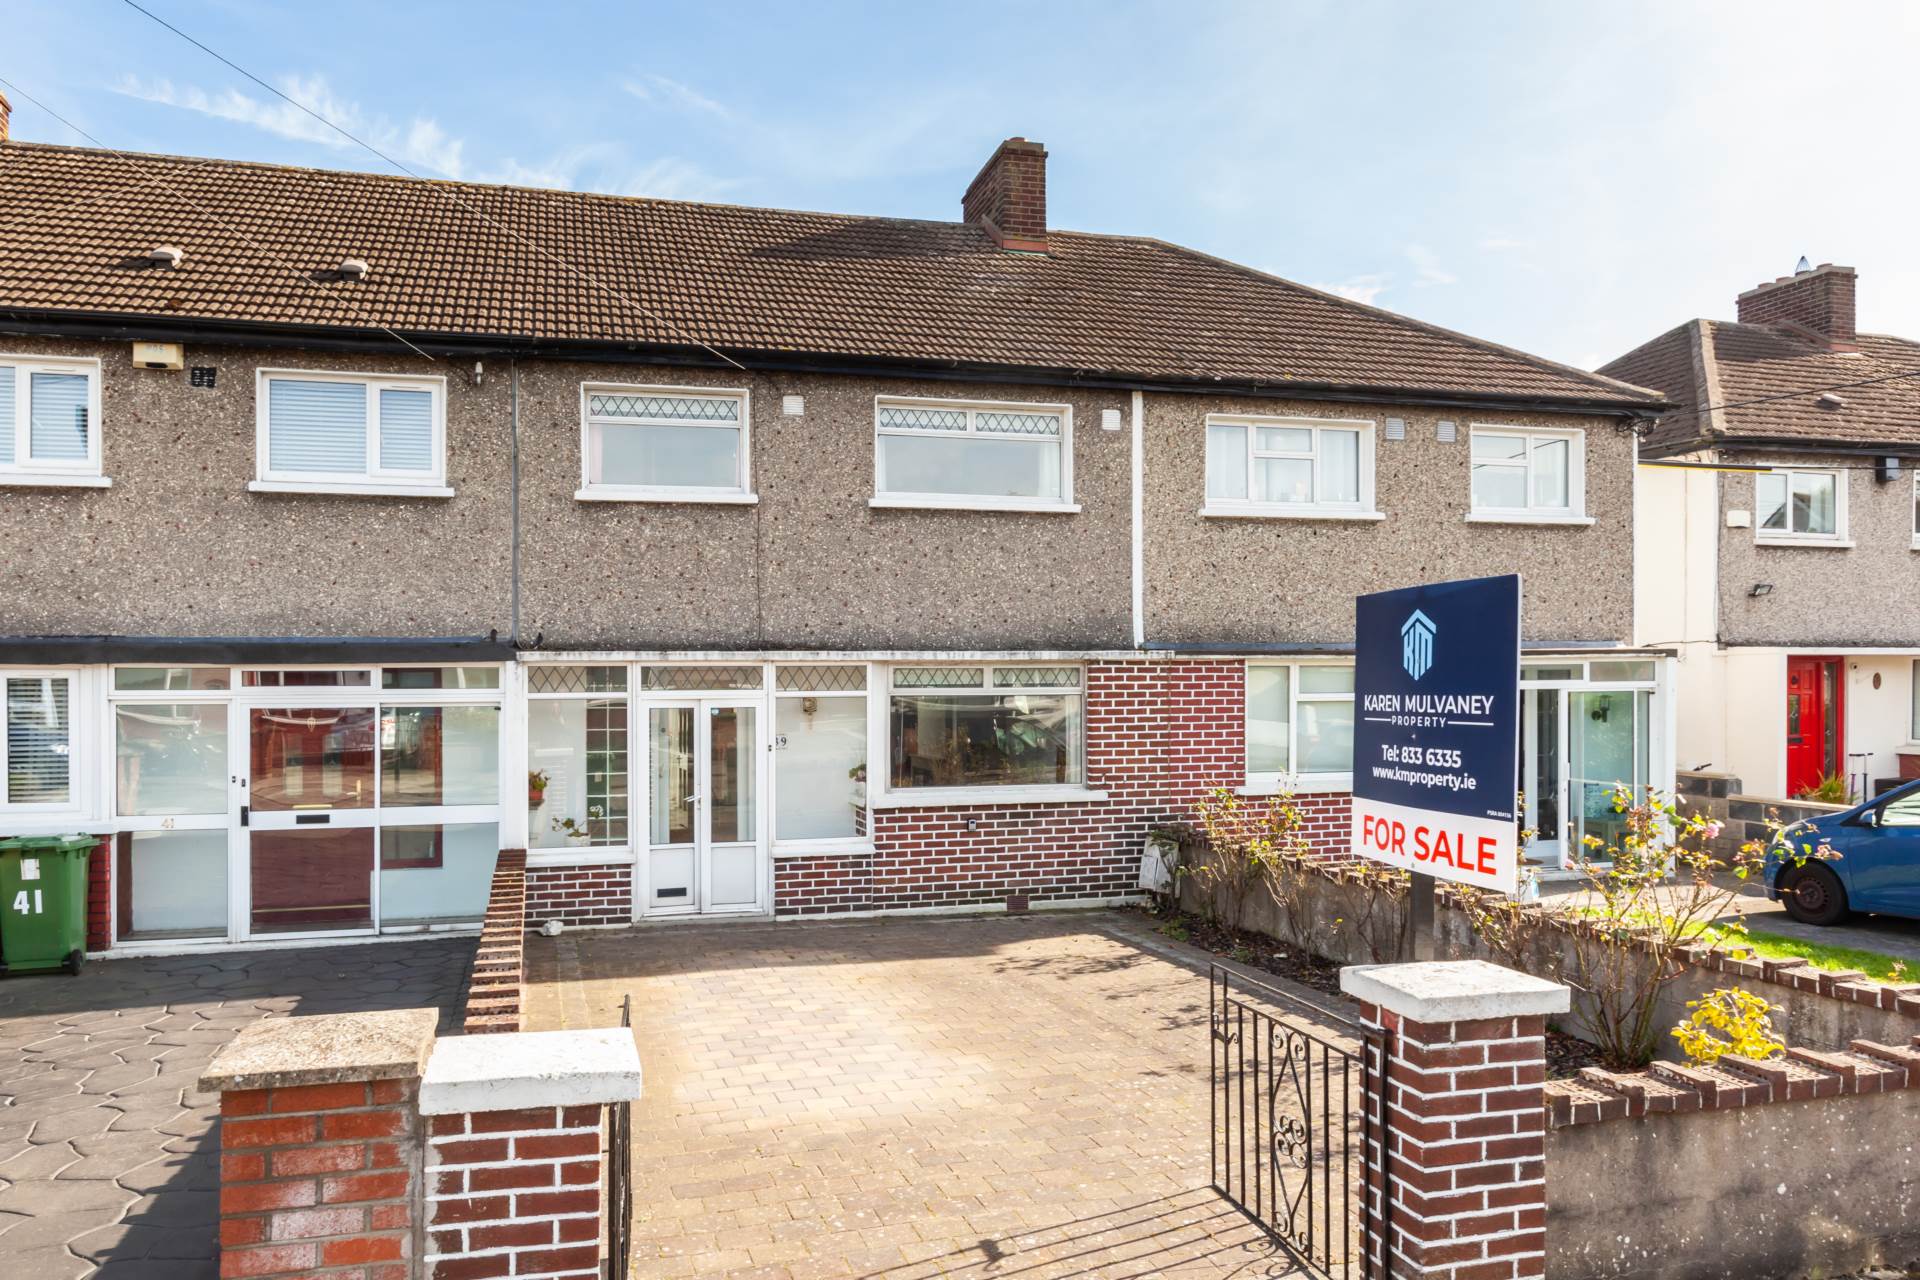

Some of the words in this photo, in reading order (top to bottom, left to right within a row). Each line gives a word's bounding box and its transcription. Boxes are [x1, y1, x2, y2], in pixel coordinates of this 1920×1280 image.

[1364, 694, 1401, 712] KAREN
[1405, 695, 1494, 715] MULVANEY
[1391, 715, 1447, 728] PROPERTY
[1381, 744, 1399, 762] Tel:
[1401, 746, 1423, 765] 833
[1426, 748, 1462, 768] 6335
[1372, 766, 1477, 791] www.kmproperty.ie
[1363, 814, 1406, 857] FOR
[1413, 826, 1497, 876] SALE
[13, 889, 43, 915] 41
